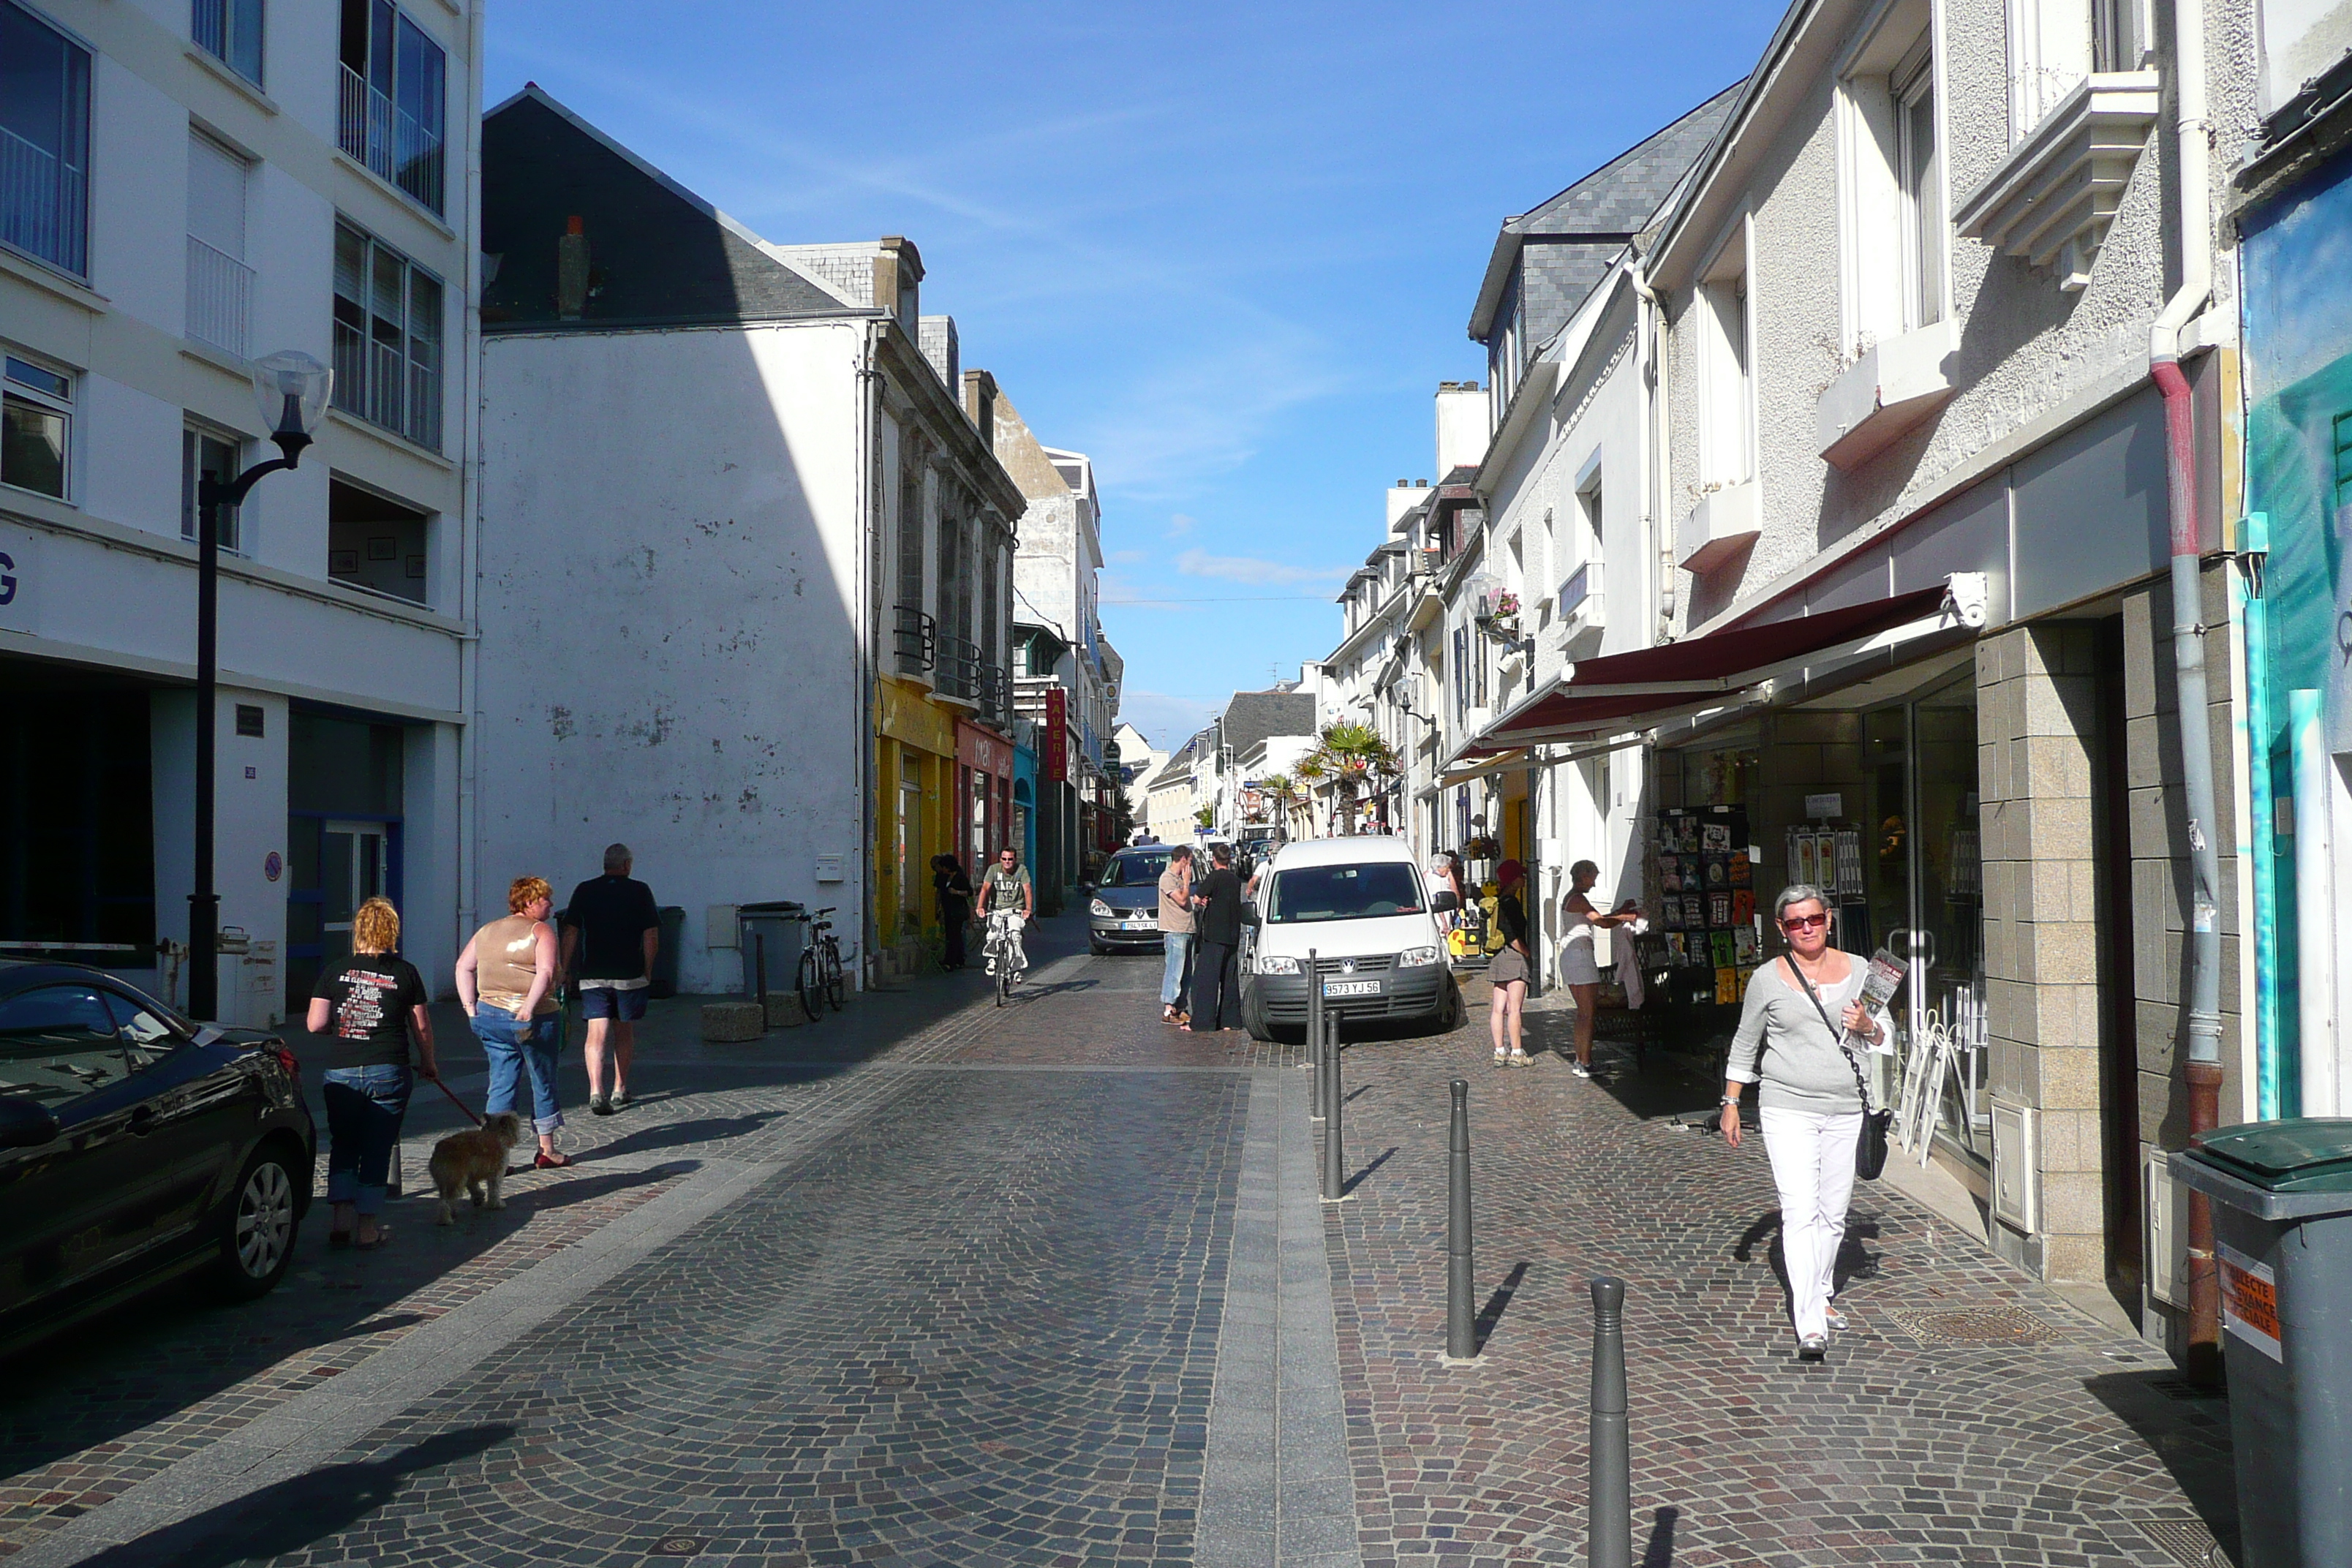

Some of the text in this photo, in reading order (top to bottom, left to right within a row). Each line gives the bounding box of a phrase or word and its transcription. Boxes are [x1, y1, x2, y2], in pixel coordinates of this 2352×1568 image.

[1052, 692, 1063, 778] LAVERIE
[1326, 982, 1379, 995] 9573 YJ 56
[2225, 1264, 2269, 1298] OLLECTE
